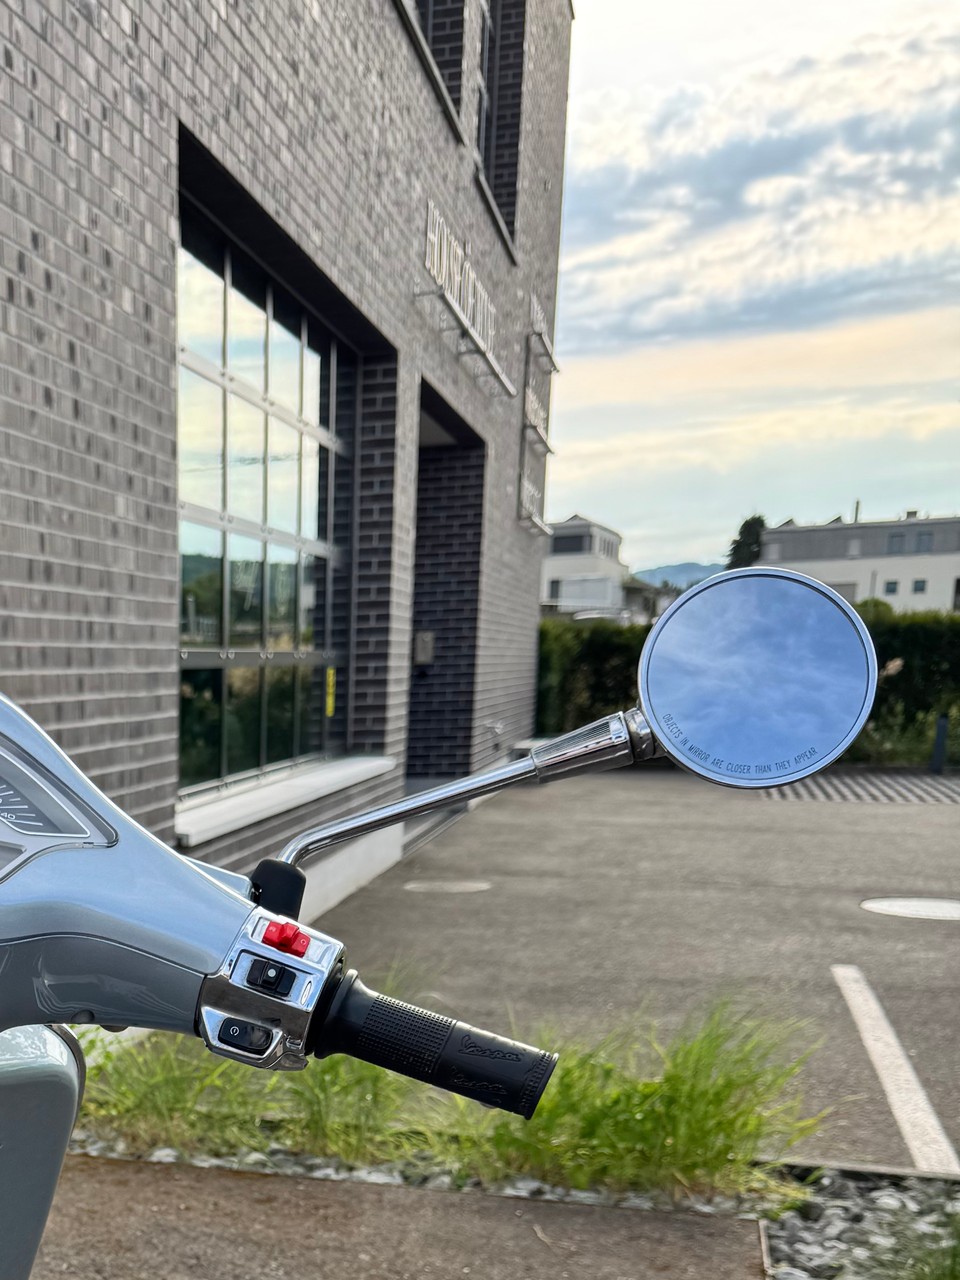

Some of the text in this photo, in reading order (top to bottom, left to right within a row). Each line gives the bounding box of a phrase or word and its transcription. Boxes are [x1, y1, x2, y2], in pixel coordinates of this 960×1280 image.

[662, 713, 683, 739] OBJECTS
[688, 744, 710, 762] MIRROR
[710, 758, 723, 769] ARE
[726, 762, 751, 774] CLOSER
[754, 764, 772, 774] THAN
[774, 760, 791, 771] THEY
[794, 746, 818, 765] APPEAR
[457, 1034, 523, 1062] Vespa
